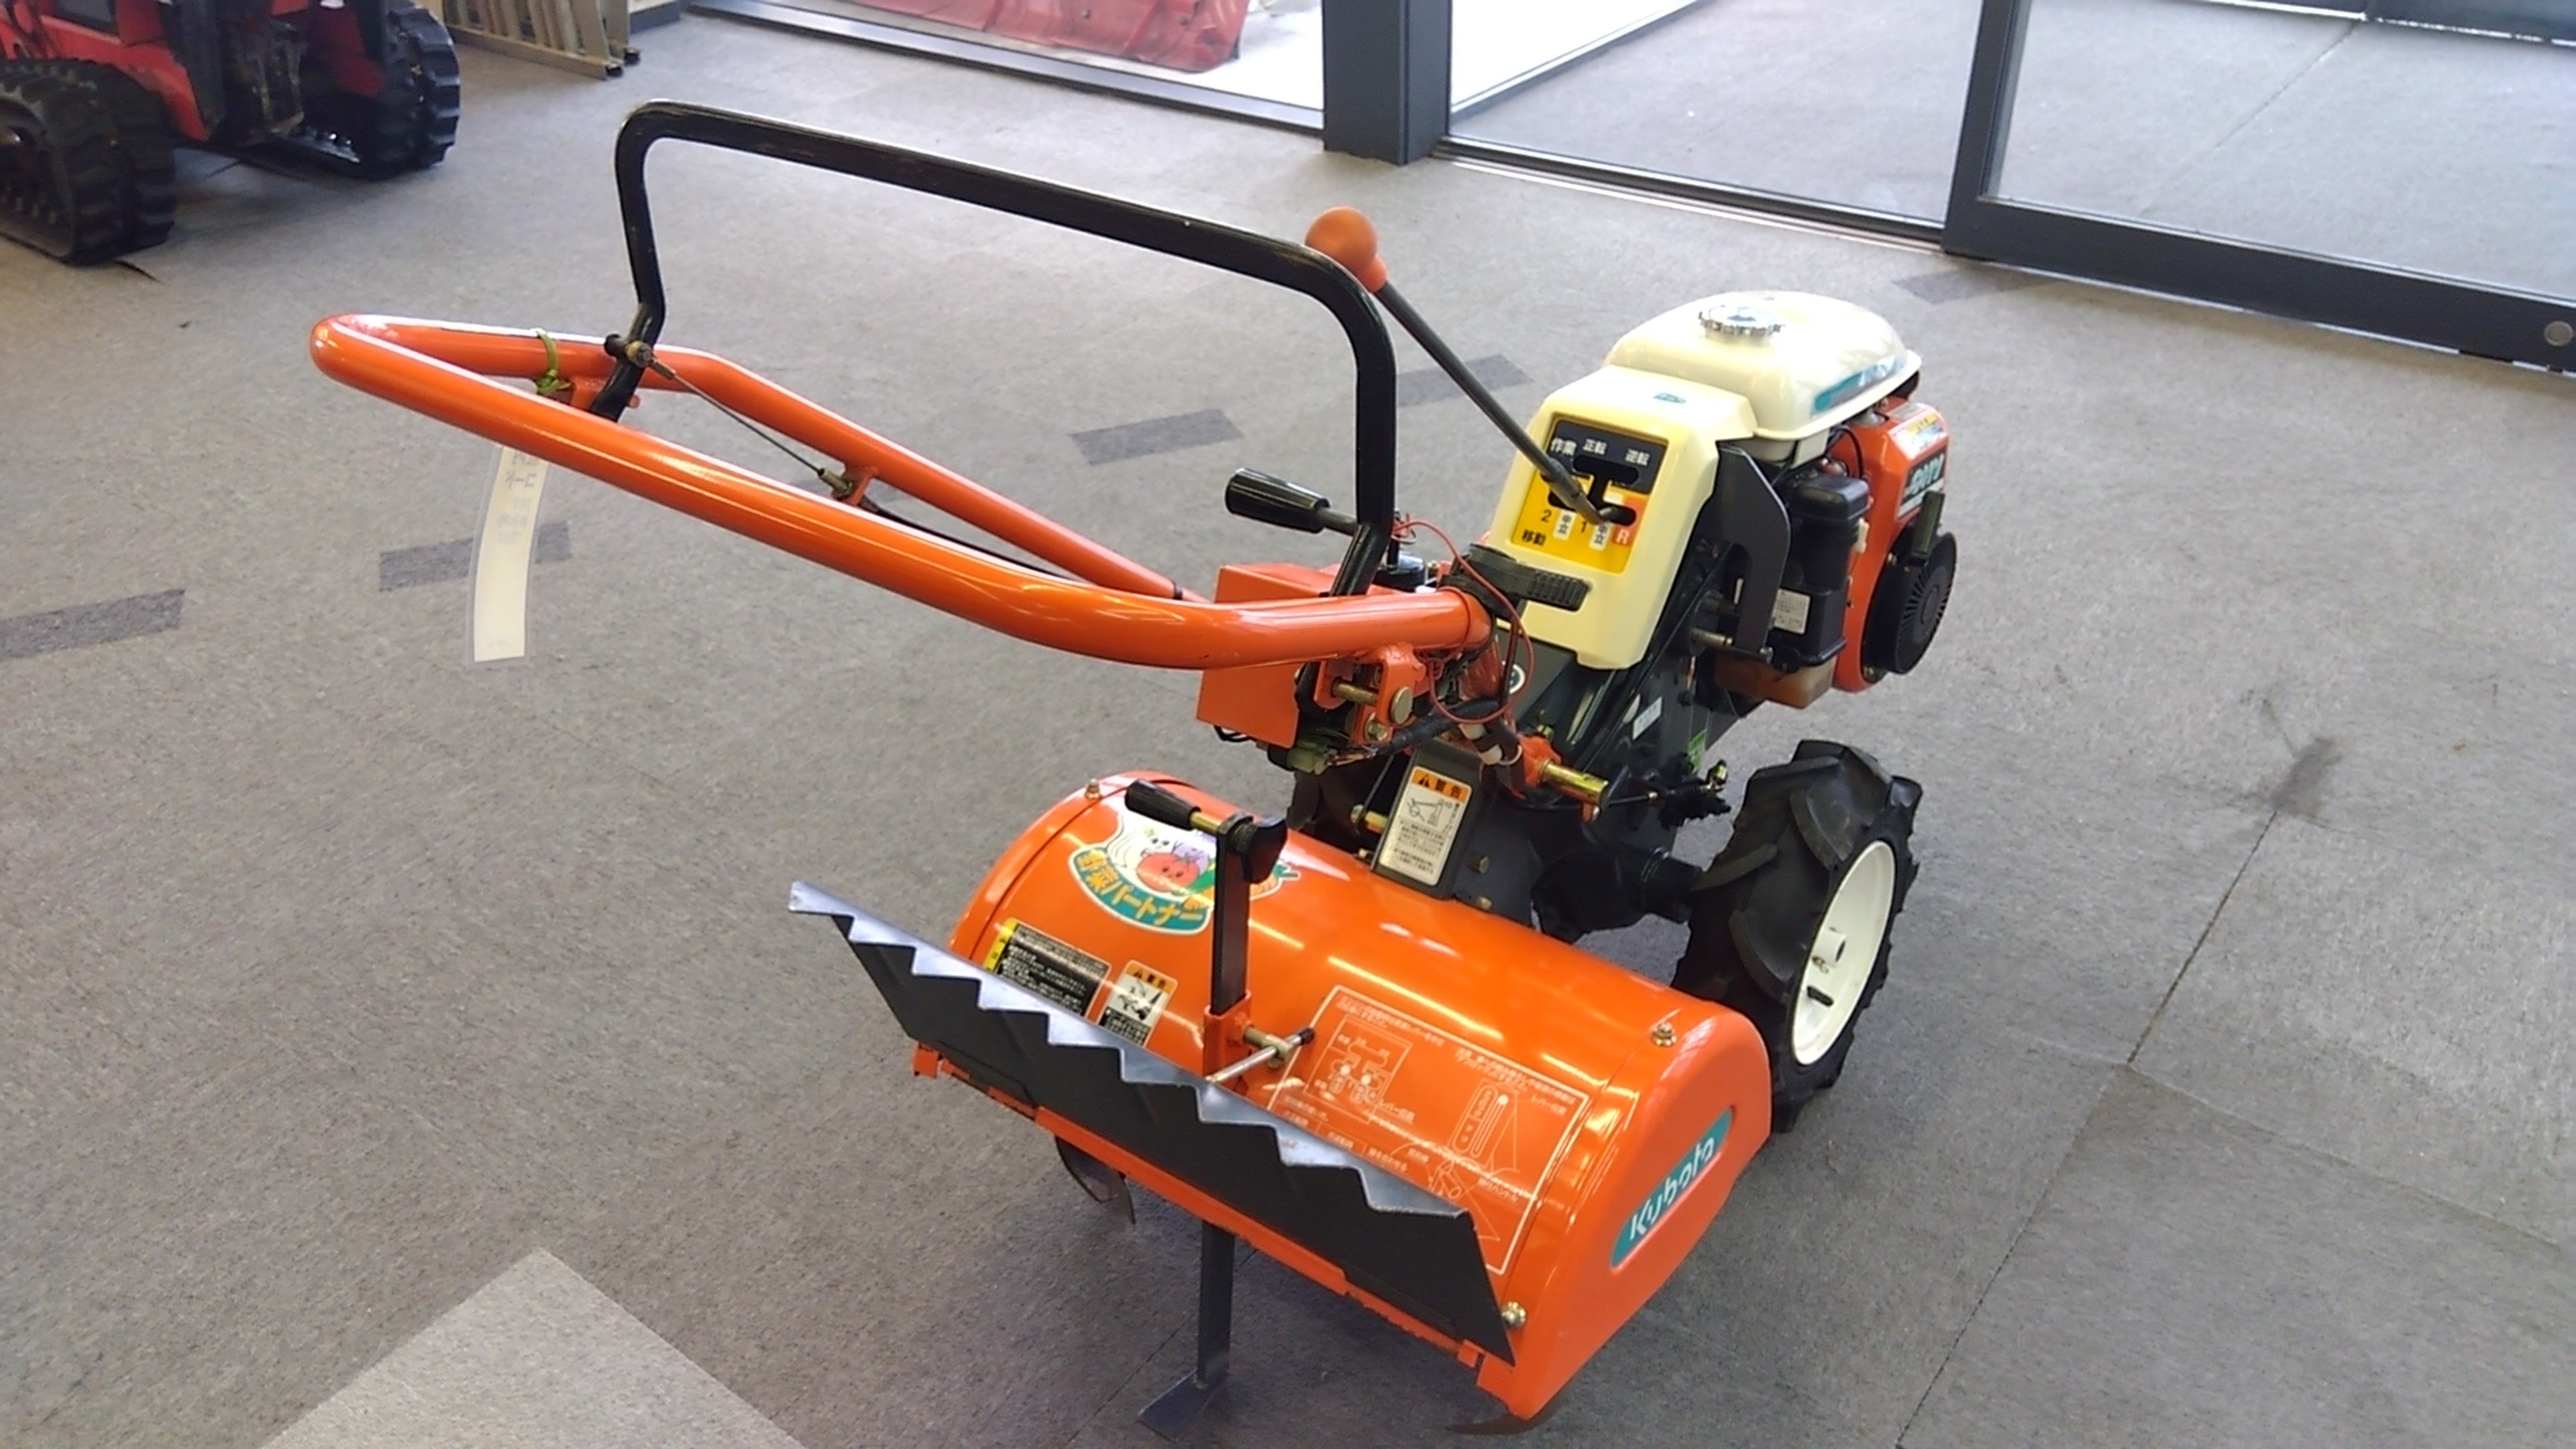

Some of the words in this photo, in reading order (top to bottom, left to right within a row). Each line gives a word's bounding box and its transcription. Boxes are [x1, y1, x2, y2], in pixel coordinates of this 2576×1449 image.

[1550, 437, 1576, 456] 作業
[1582, 438, 1607, 455] 正転
[1625, 449, 1650, 466] 逆転
[1541, 510, 1552, 523] 2
[1558, 515, 1572, 535] 中立
[1581, 521, 1587, 533] 1
[1595, 524, 1608, 545] 中立
[1521, 529, 1546, 546] 移動
[1616, 529, 1630, 544] R
[1630, 1137, 1715, 1240] Kubota
